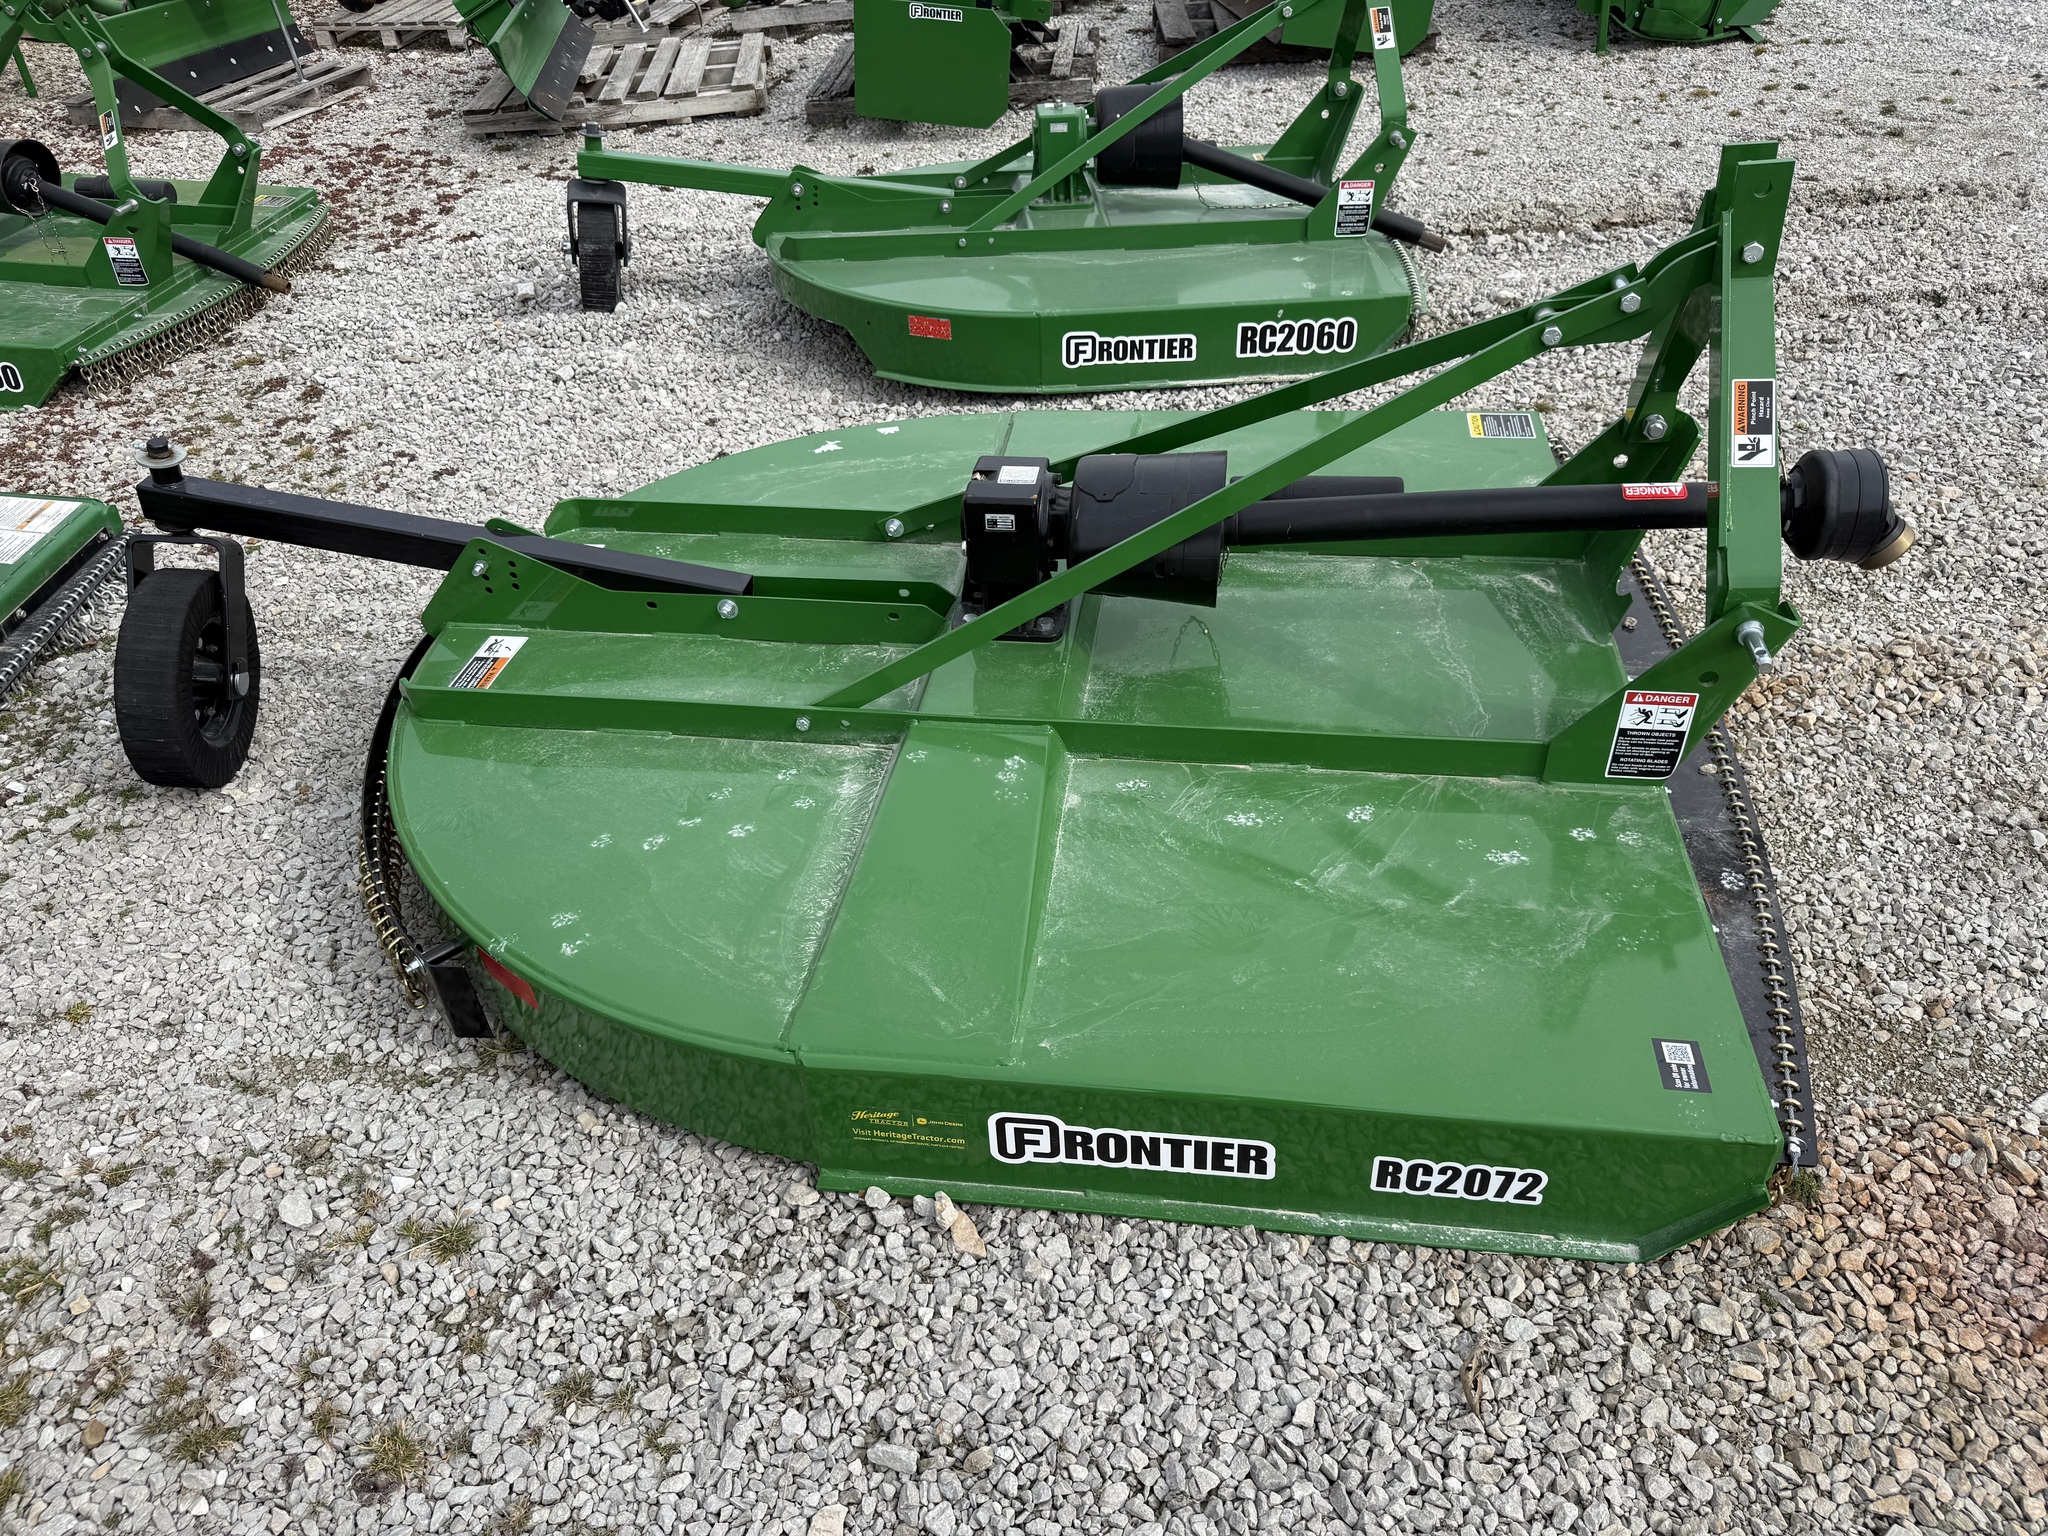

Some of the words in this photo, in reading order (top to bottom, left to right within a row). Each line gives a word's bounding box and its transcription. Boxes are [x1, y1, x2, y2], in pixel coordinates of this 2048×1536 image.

[910, 3, 962, 21] FRONTIER
[1239, 320, 1355, 354] RC2060
[1066, 335, 1193, 365] FRONTIER
[1626, 486, 1669, 495] DANGER
[1645, 694, 1690, 703] DANGER
[1680, 1067, 1688, 1081] owner
[1687, 1064, 1699, 1089] information
[851, 1110, 899, 1120] Heritage
[869, 1118, 908, 1126] TRACTOR
[852, 1128, 871, 1136] Visit
[874, 1130, 965, 1144] HeritageTractor.com
[996, 1116, 1268, 1176] FRONTIER
[1376, 1160, 1543, 1202] RC2072
